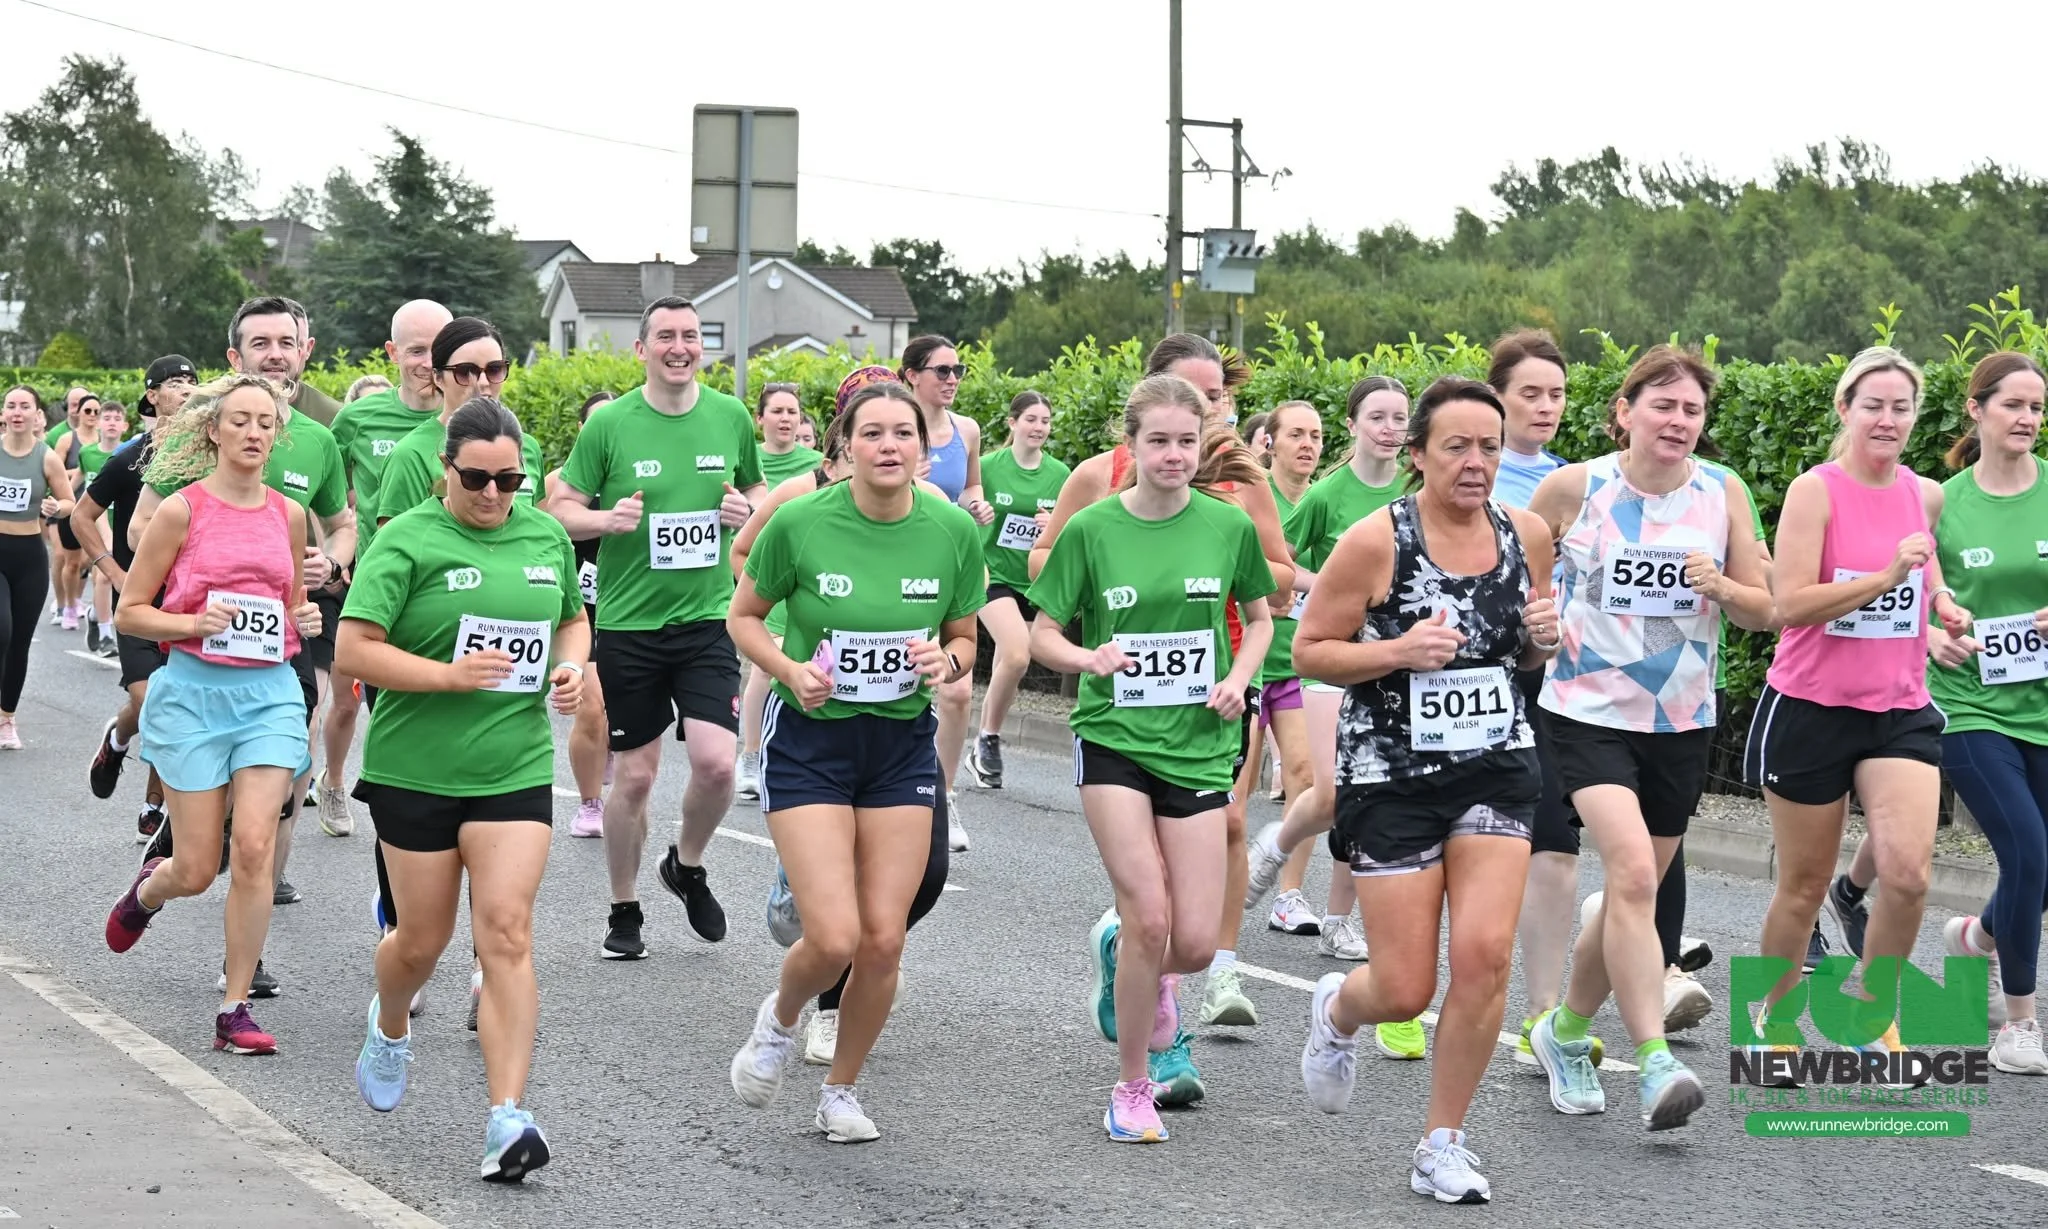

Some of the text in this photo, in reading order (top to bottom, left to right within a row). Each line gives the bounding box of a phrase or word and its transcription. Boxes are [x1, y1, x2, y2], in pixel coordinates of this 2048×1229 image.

[0, 486, 27, 499] 237
[677, 515, 711, 524] NEWBRIDGE
[656, 524, 716, 547] 5004
[1624, 548, 1640, 556] RUN
[1640, 590, 1668, 598] KAREN
[238, 599, 274, 610] NEWBRIDGE
[232, 610, 278, 636] 052
[1990, 622, 2006, 631] RUN
[478, 623, 540, 635] RUN NEWBRIDGE
[850, 637, 866, 646] RUN
[1130, 637, 1198, 648] RUN NEWBRIDGE
[1122, 648, 1206, 678] 5187
[2014, 656, 2036, 664] FIONA
[868, 676, 892, 684] LAURA
[1157, 679, 1175, 687] AMY
[1428, 674, 1494, 688] RUN NEWBRIDGE
[1420, 686, 1508, 720] 5011
[1453, 720, 1480, 730] AILISH
